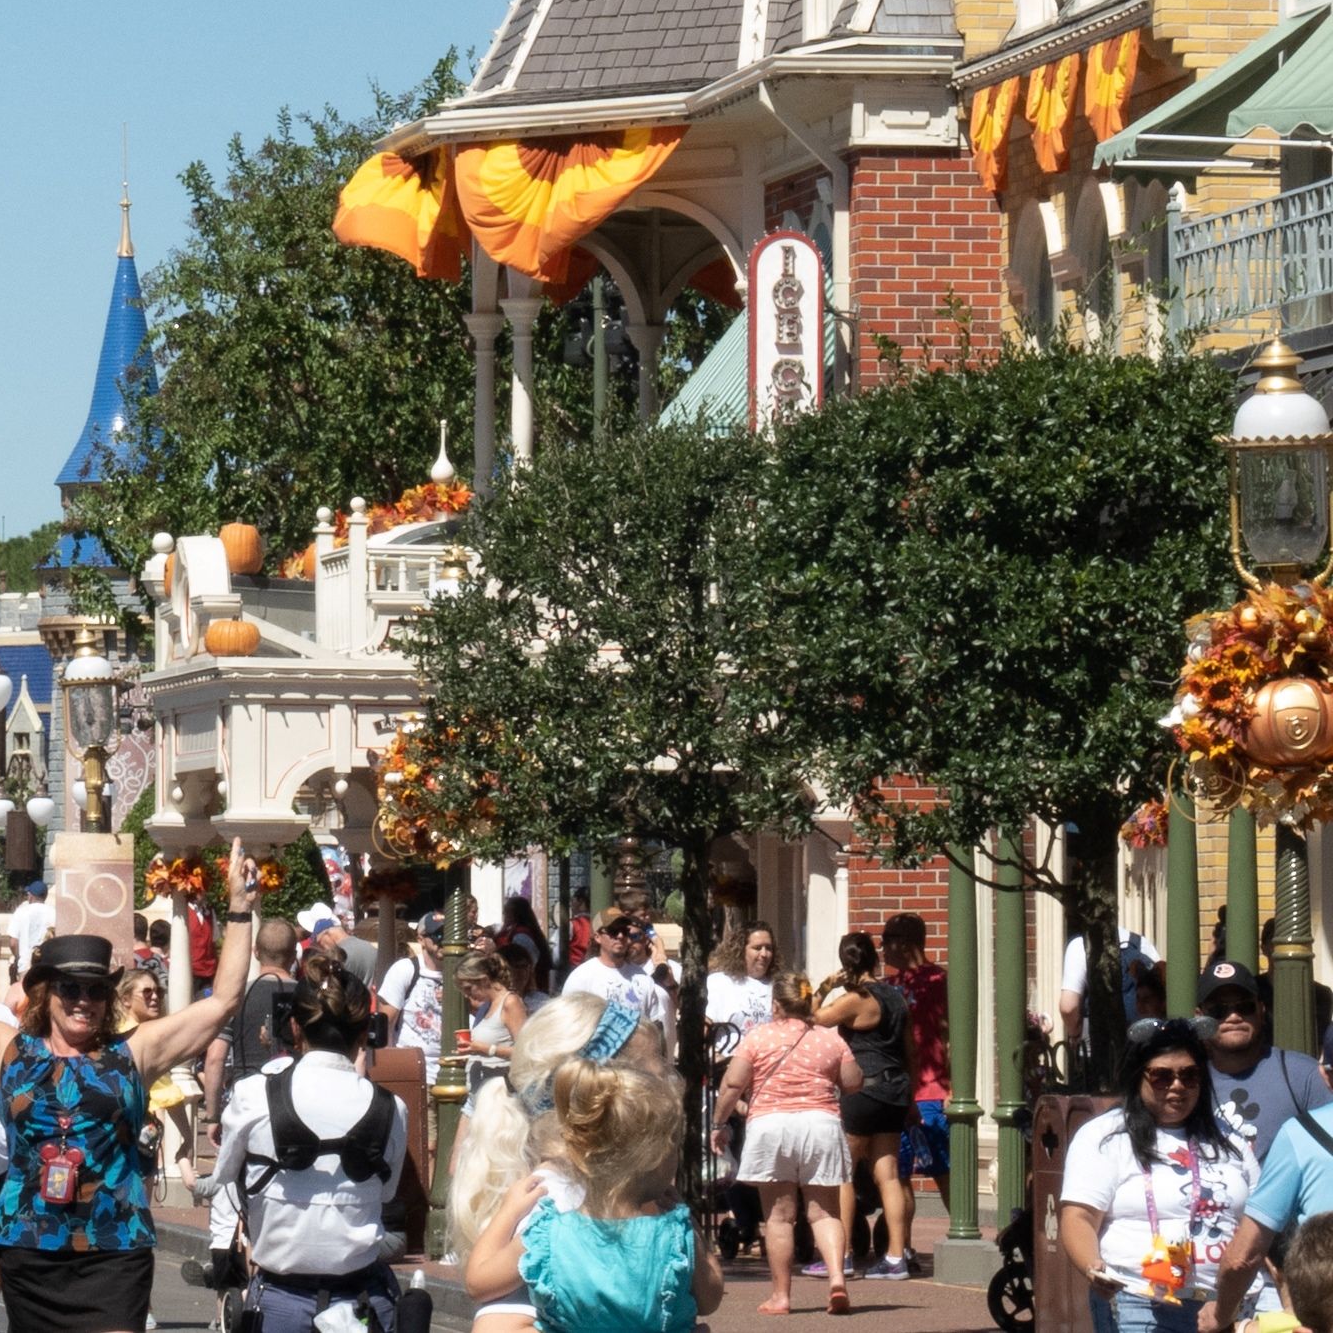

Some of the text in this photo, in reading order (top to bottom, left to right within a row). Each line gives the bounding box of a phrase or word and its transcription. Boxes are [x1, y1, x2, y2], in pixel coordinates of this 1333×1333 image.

[772, 245, 803, 345] ICE
[60, 868, 128, 935] 50
[1191, 1241, 1227, 1264] LO
